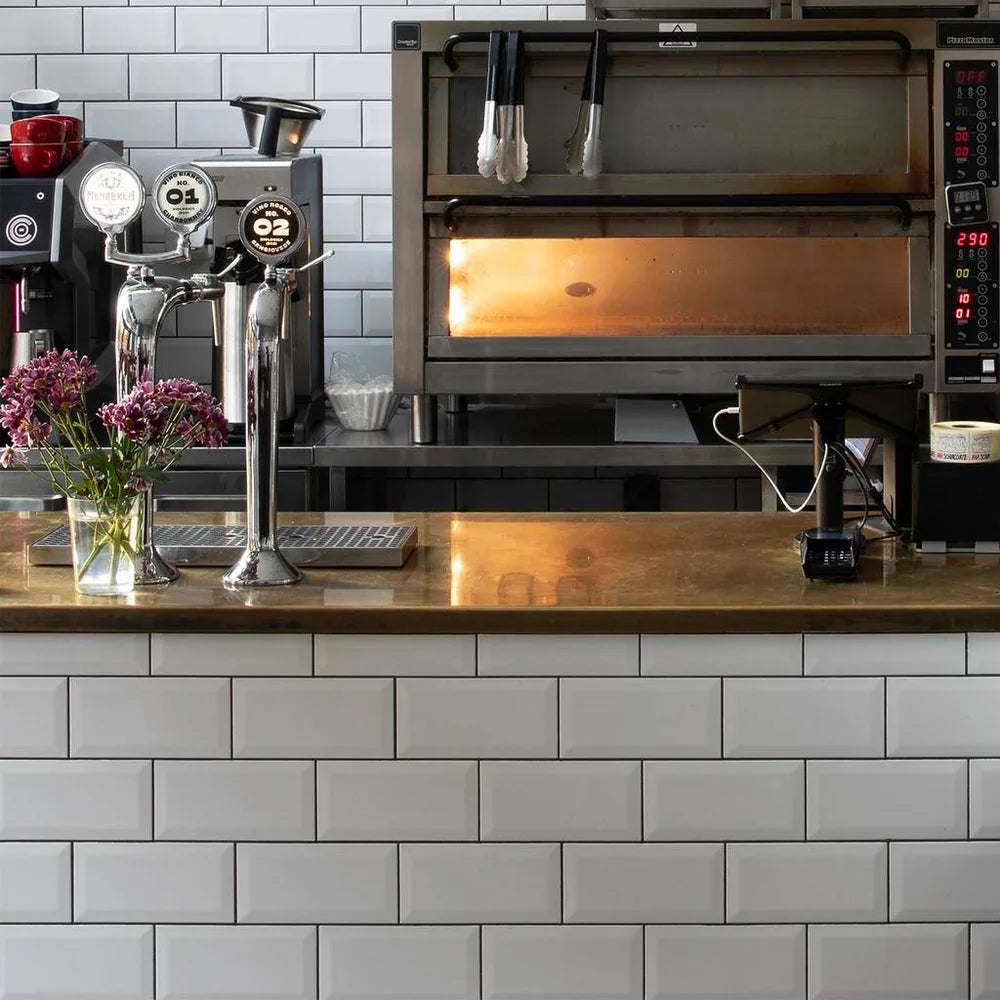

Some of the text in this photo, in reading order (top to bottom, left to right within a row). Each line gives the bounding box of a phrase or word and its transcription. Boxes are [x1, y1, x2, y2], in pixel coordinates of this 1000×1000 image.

[946, 36, 994, 44] PizzaMaster
[956, 71, 986, 85] OFF
[162, 171, 203, 186] VINO BIANCO
[166, 188, 199, 205] 01
[252, 202, 292, 216] VINO ROSSO
[253, 218, 290, 236] 02
[251, 239, 292, 253] SANGIOVESE
[957, 232, 988, 246] 290
[955, 268, 970, 278] 00
[959, 293, 970, 304] 10
[955, 308, 971, 319] 01
